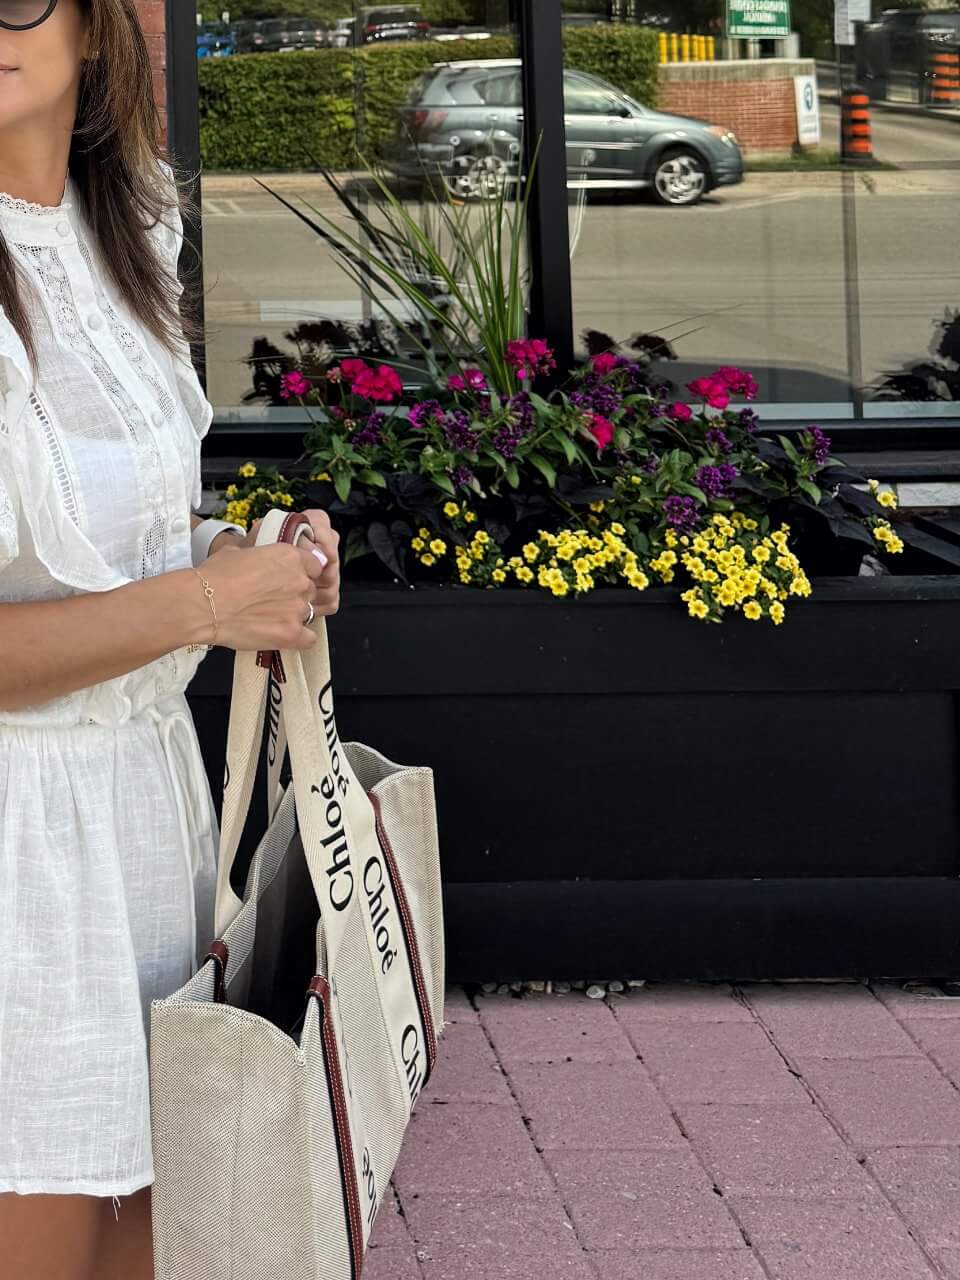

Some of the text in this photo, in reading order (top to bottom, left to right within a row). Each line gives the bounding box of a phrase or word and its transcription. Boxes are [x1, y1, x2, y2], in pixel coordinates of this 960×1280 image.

[311, 772, 354, 912] Chloé
[363, 856, 398, 975] Chloé
[401, 1024, 422, 1111] Chl
